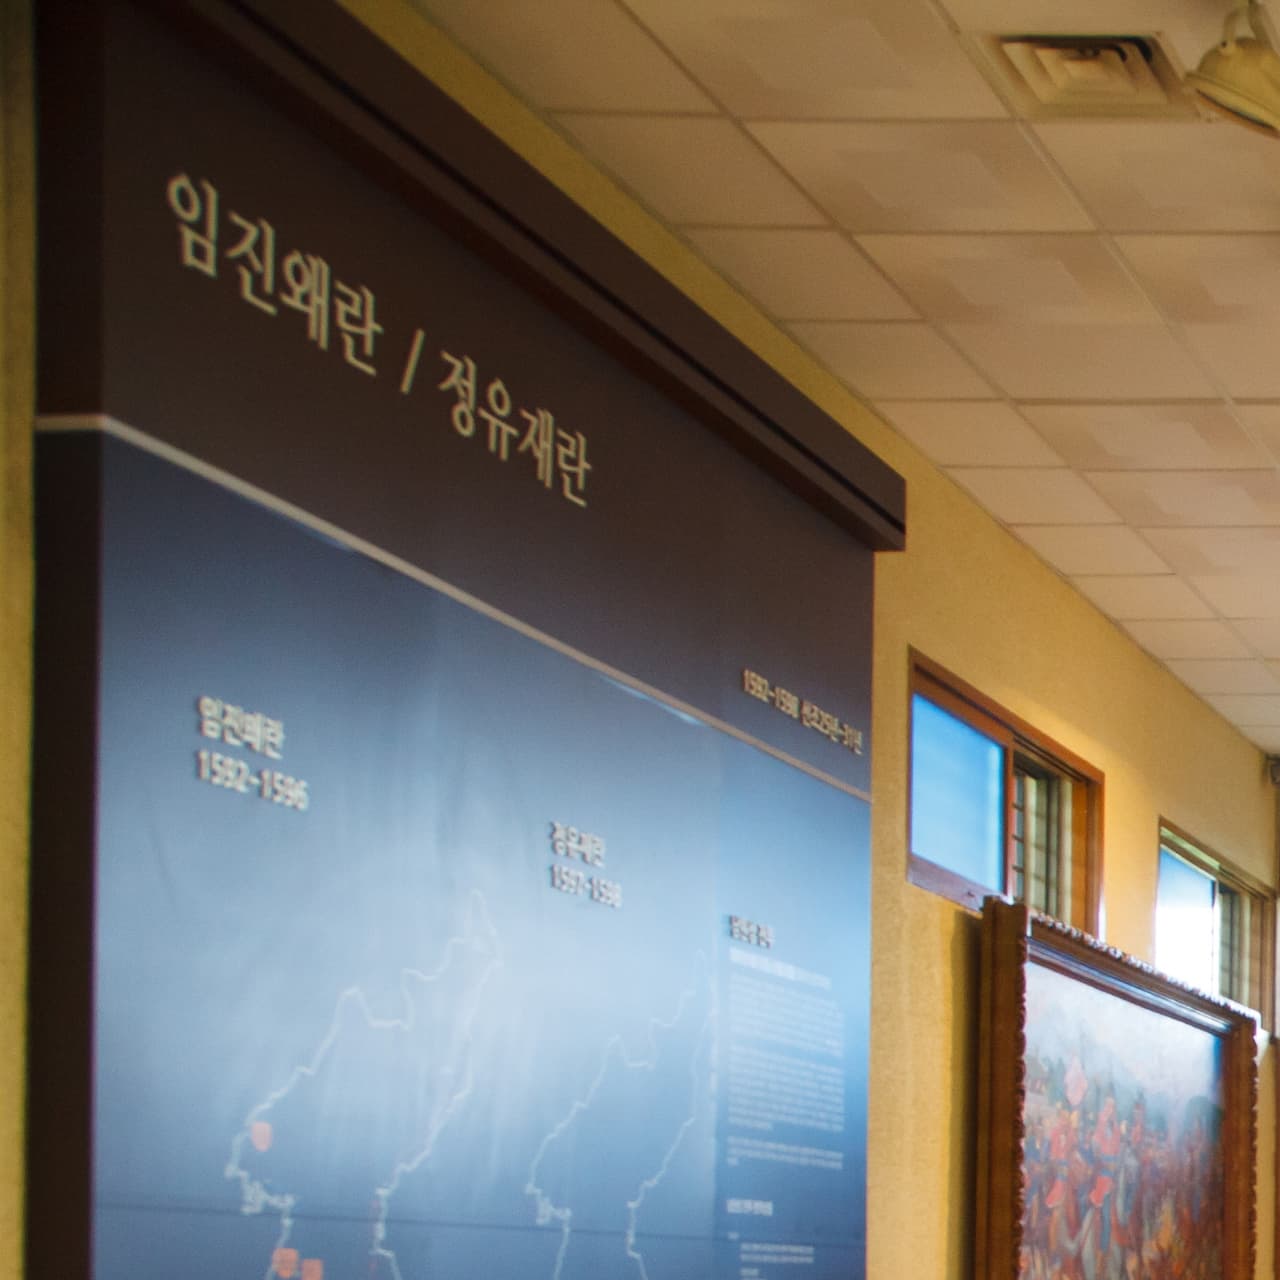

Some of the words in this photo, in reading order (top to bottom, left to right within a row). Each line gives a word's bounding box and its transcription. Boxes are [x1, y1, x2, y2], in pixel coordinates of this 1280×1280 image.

[167, 172, 383, 376] 임진왜란
[400, 328, 425, 396] /
[438, 350, 593, 509] 정유재란
[199, 696, 285, 761] 임진왜란
[550, 821, 606, 869] 정유재란
